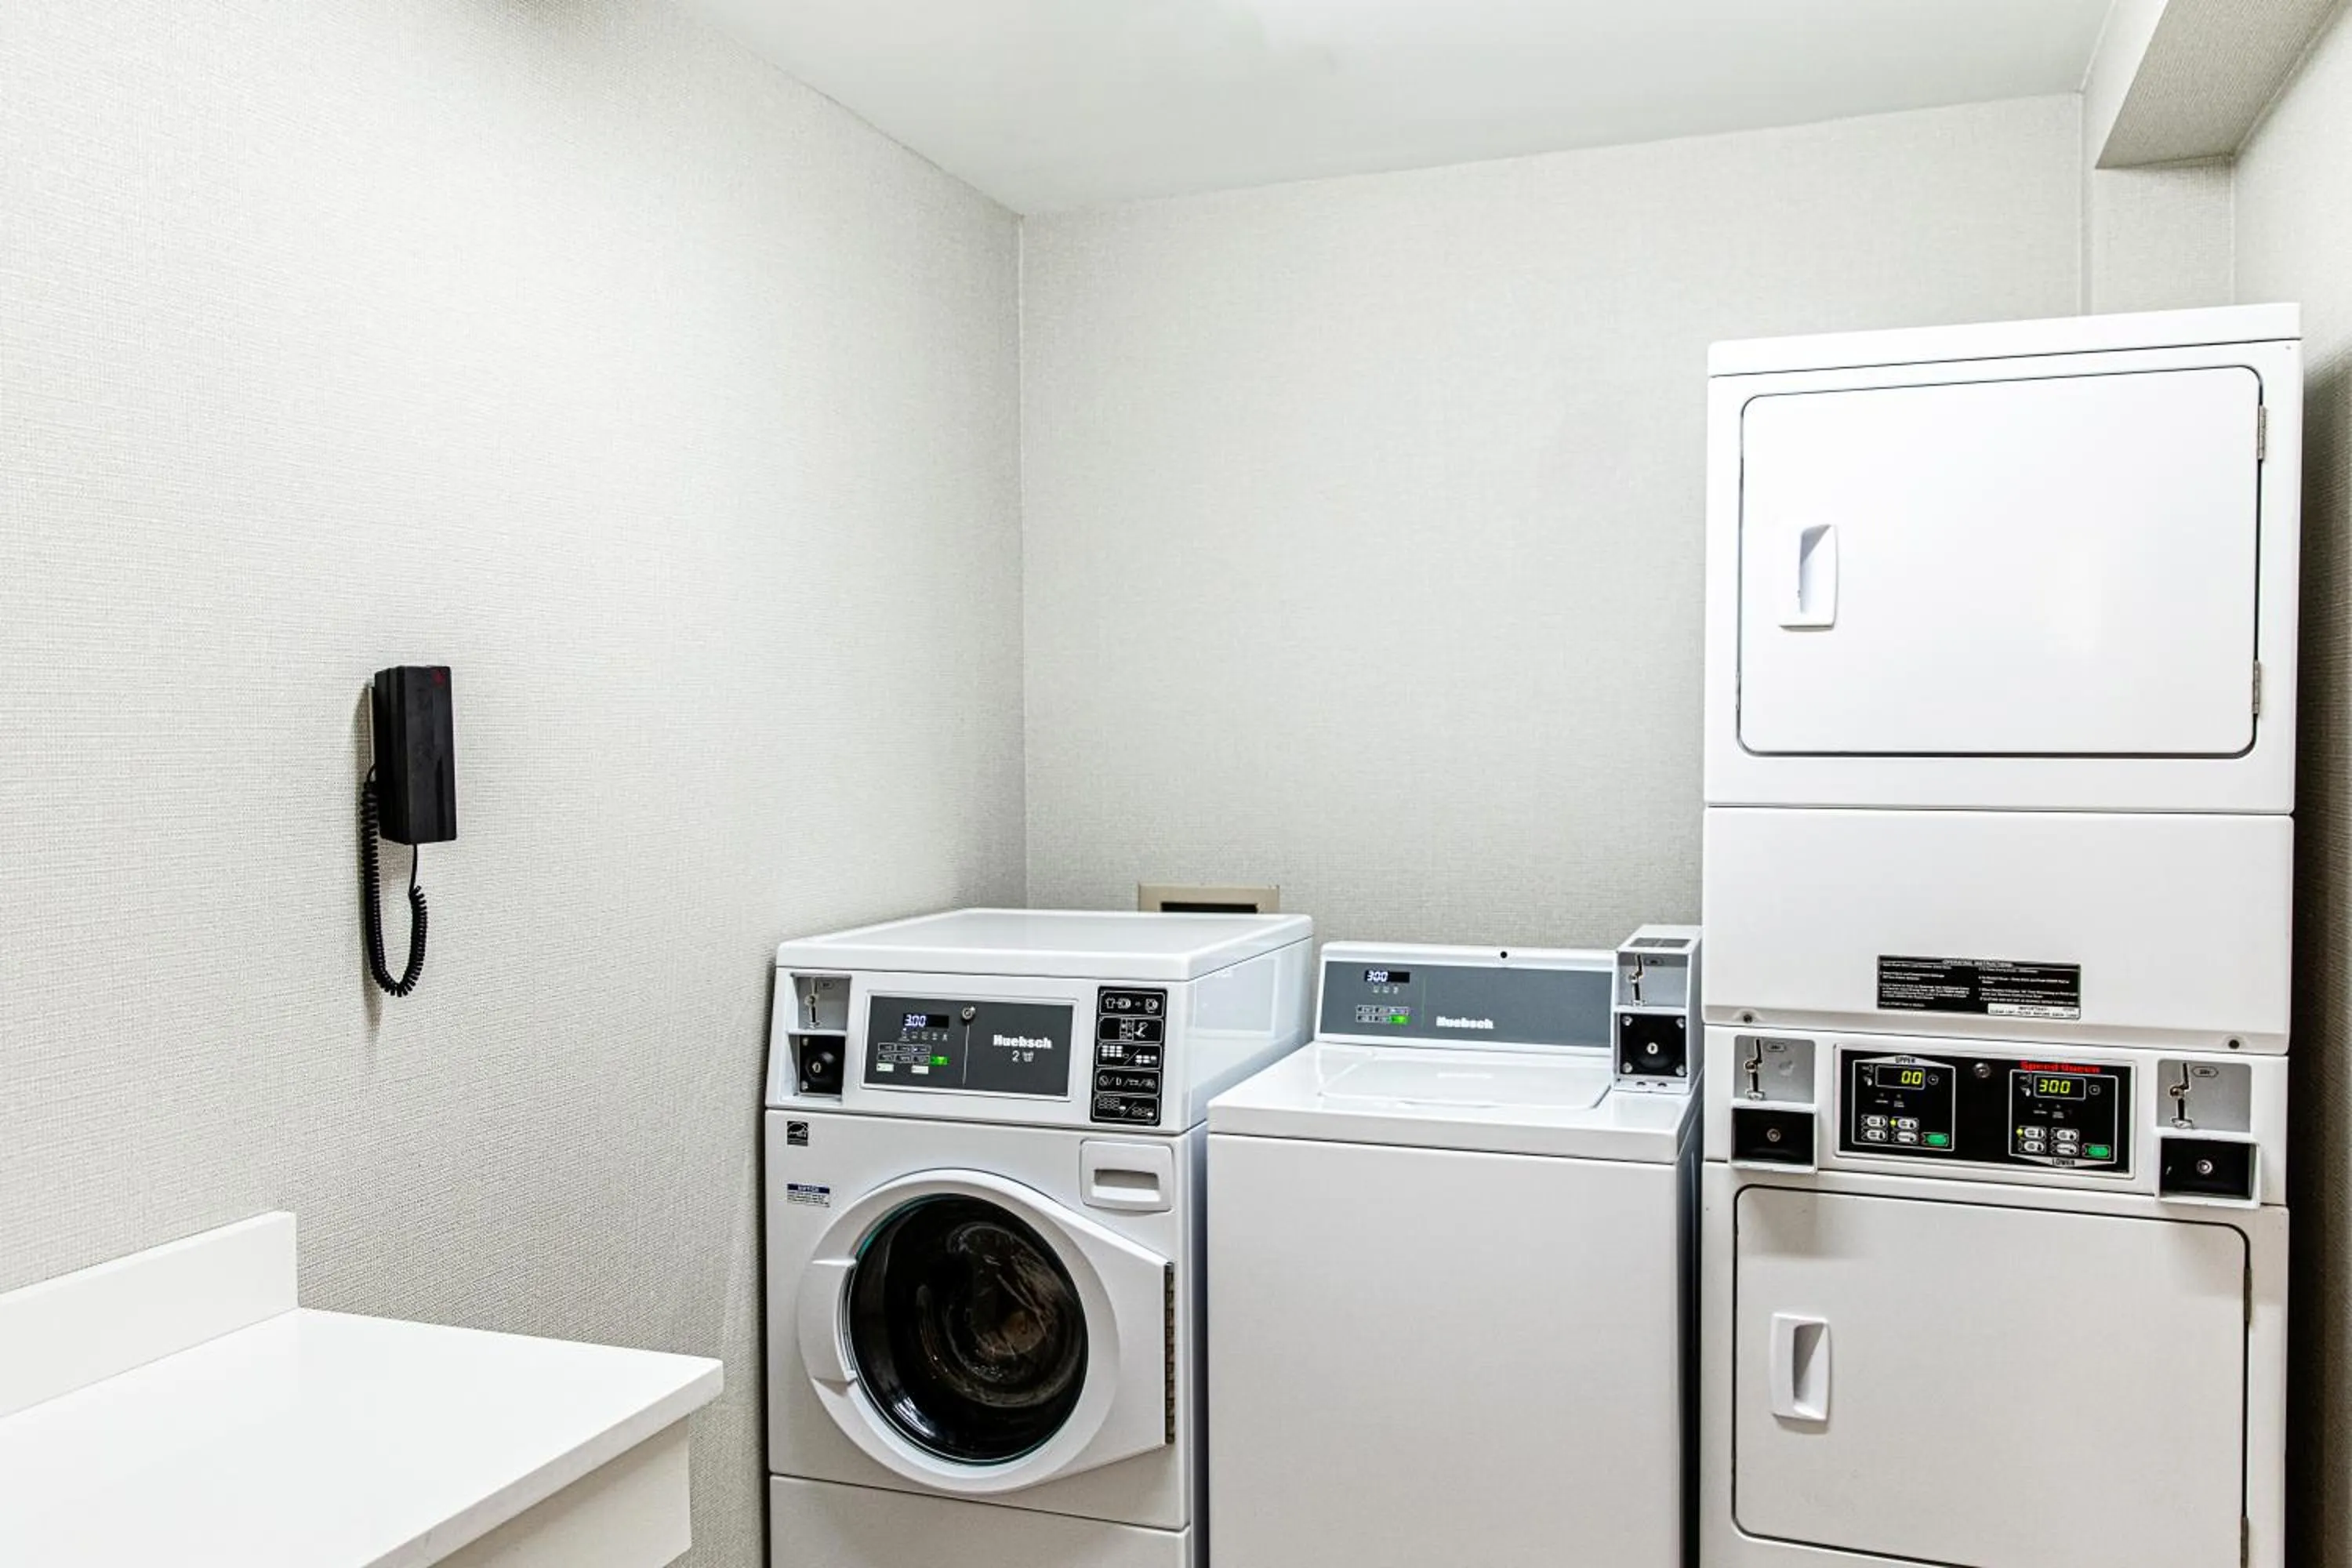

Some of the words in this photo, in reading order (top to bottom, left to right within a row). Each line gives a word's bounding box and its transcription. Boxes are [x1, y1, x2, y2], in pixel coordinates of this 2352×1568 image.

[993, 1034, 1052, 1049] Huebsch
[1901, 1070, 1922, 1085] 00
[2038, 1079, 2071, 1094] 300
